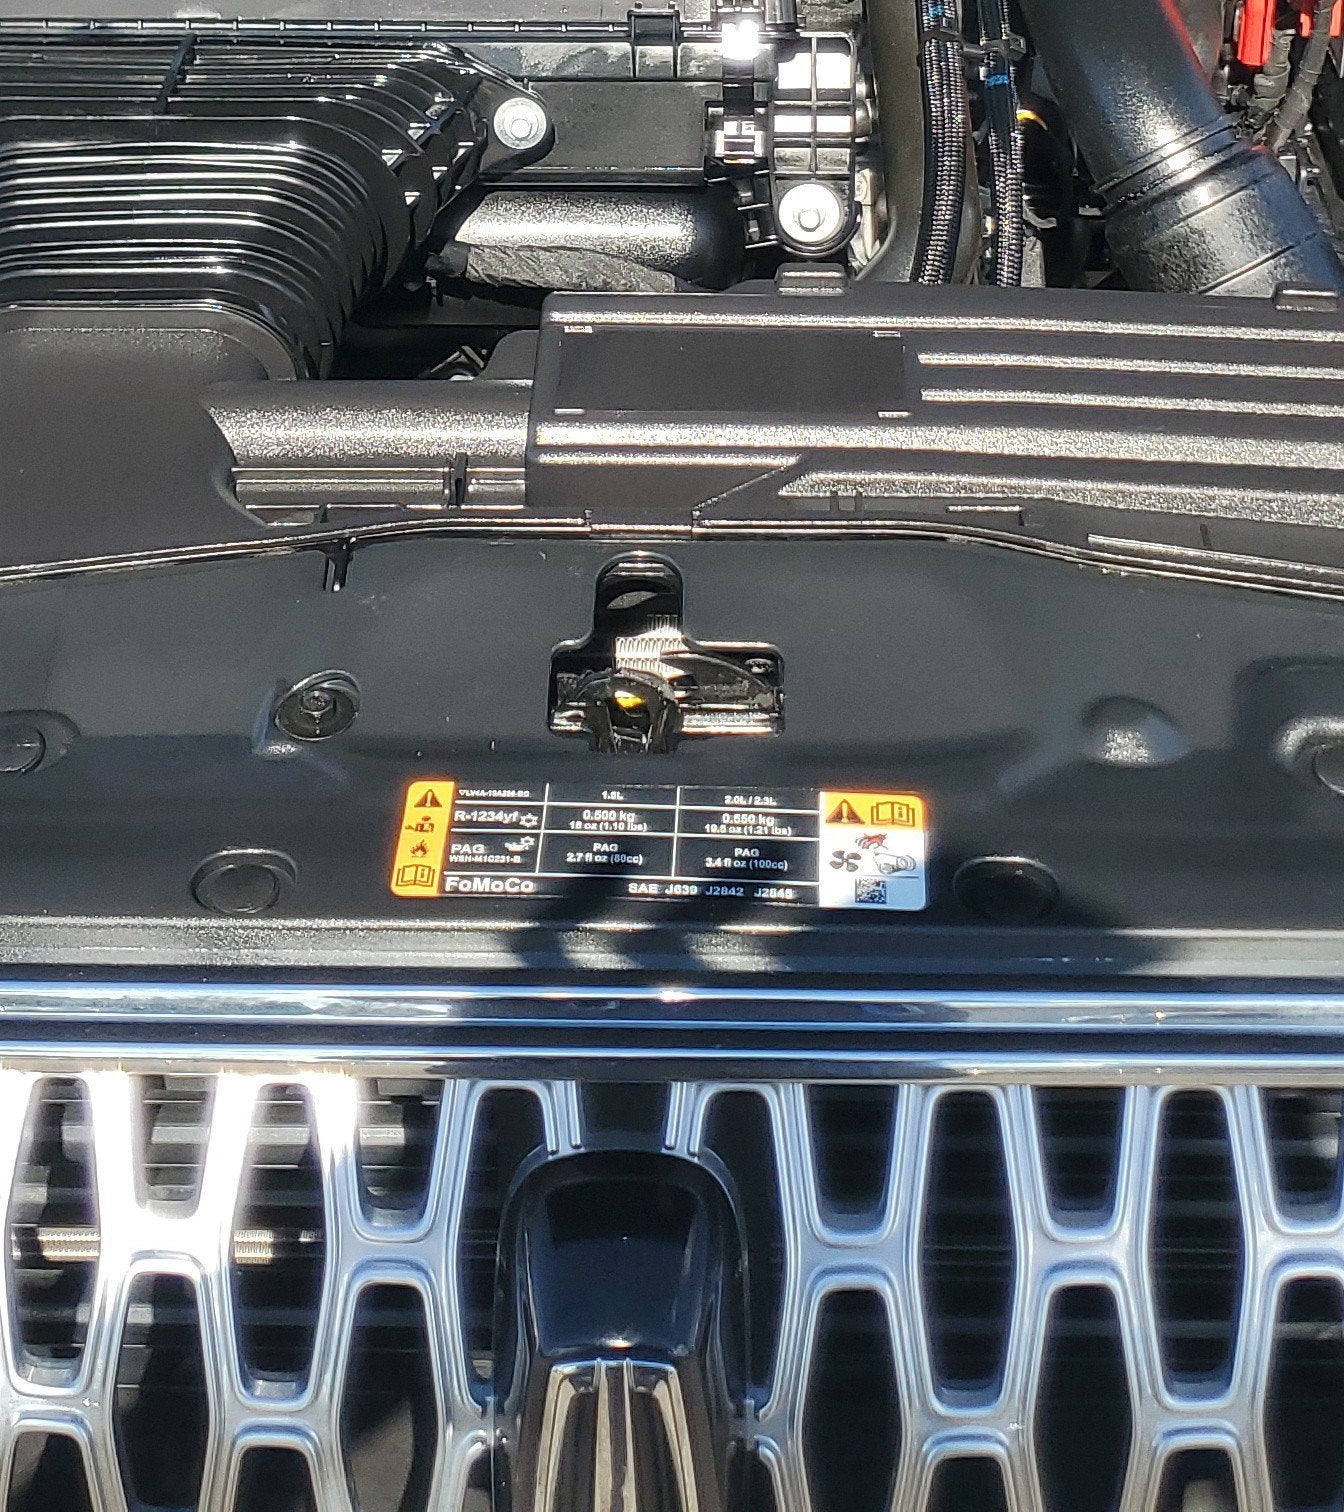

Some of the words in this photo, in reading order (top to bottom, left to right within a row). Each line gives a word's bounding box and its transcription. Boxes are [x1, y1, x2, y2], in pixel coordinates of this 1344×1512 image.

[724, 795, 747, 805] 2.0L
[753, 795, 777, 806] 2.3L
[454, 809, 519, 824] R-1234yf
[582, 809, 616, 821] 0.500
[619, 809, 636, 823] kg
[722, 813, 756, 825] 0.550
[758, 813, 775, 827] kg
[584, 822, 598, 830] oz
[599, 821, 624, 831] (1.10
[627, 822, 648, 833] lbs)
[728, 825, 742, 834] oz
[743, 825, 768, 836] (1.21
[771, 825, 792, 837] lbs)
[451, 843, 485, 854] PAG
[592, 842, 619, 852] PAG
[734, 847, 760, 858] PAG
[566, 852, 583, 863] 2.7
[584, 852, 593, 862] fl
[594, 854, 608, 863] oz
[705, 857, 722, 868] 3.4
[723, 857, 731, 868] fl
[733, 860, 747, 868] oz
[749, 859, 788, 872] (100cc)
[444, 876, 535, 894] FoMoCo
[628, 882, 659, 894] SAE
[664, 884, 698, 896] J639
[705, 885, 745, 897] J2842
